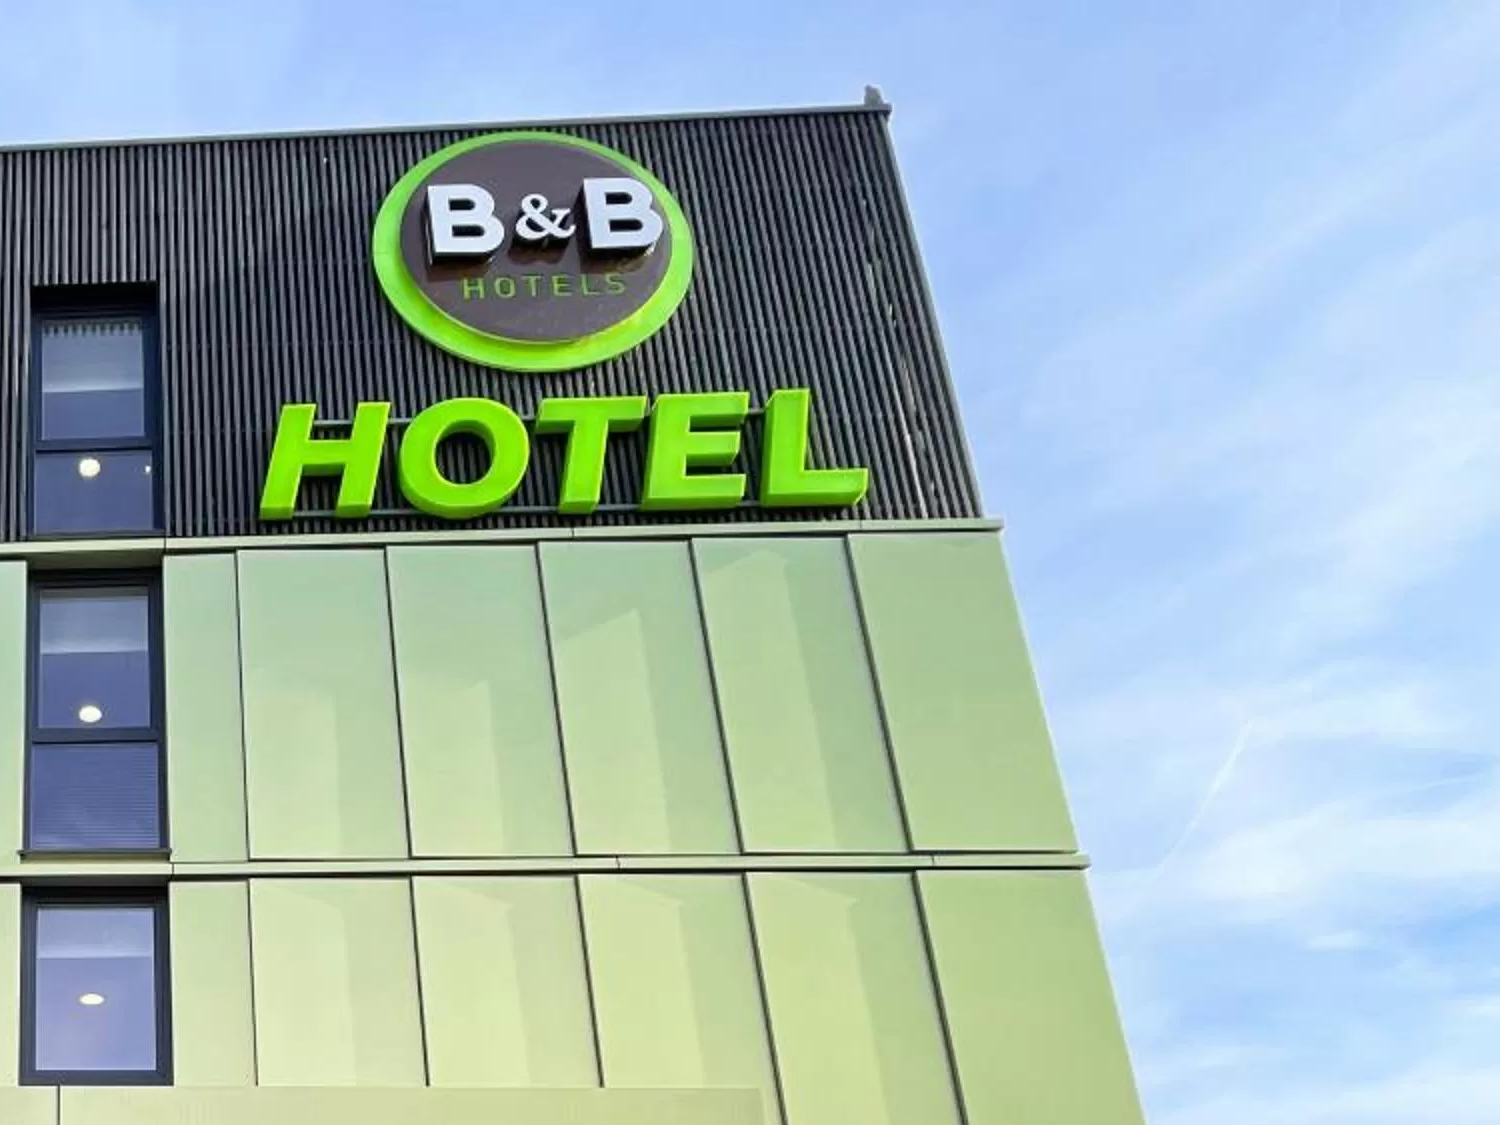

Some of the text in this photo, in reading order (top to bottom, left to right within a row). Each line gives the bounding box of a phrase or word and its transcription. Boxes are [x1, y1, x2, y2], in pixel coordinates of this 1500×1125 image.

[426, 177, 664, 258] B&B
[461, 273, 627, 300] HOTELS
[259, 387, 869, 521] HOTEL
